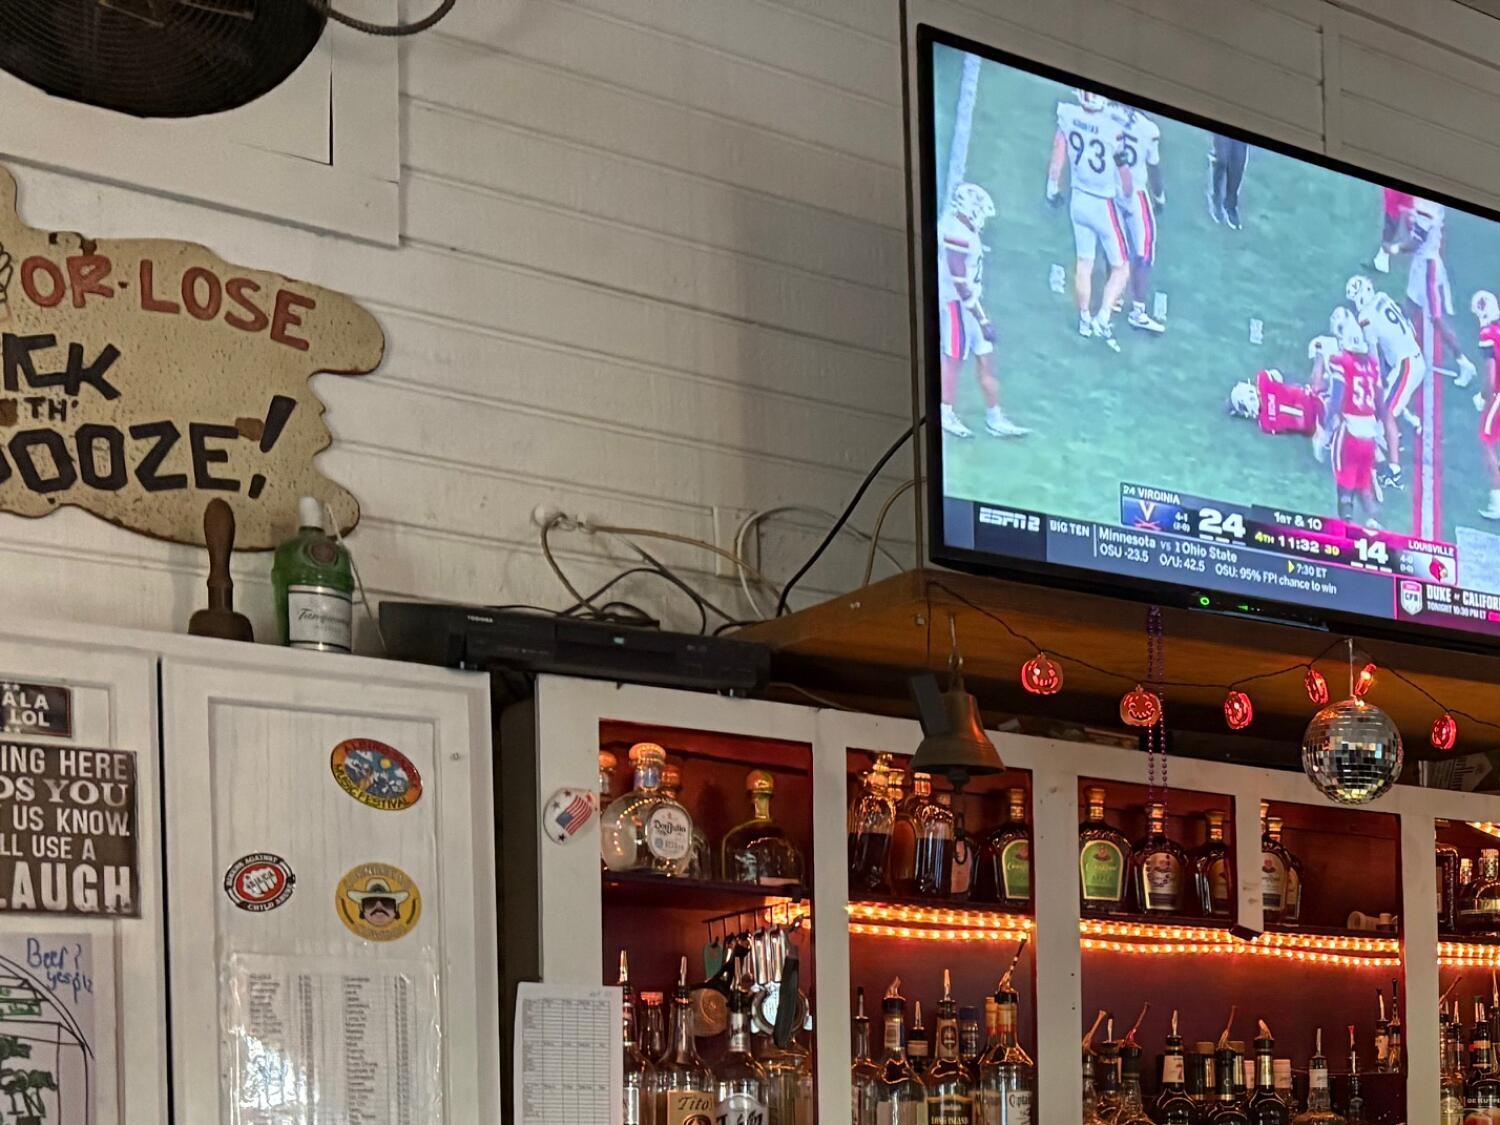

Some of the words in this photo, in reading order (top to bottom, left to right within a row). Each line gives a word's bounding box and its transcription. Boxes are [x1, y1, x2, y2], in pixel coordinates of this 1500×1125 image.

[1069, 131, 1106, 174] 93
[20, 255, 114, 308] OR
[139, 259, 316, 351] LOSE
[0, 395, 297, 498] OOZE!
[1137, 487, 1180, 505] VIRGINIA
[1050, 518, 1068, 534] BIG
[1069, 522, 1090, 538] TEN
[1199, 508, 1246, 539] 24
[1307, 518, 1322, 531] 10
[1099, 528, 1156, 549] Minnesota
[1160, 541, 1172, 552] vs
[1181, 541, 1207, 558] Ohio
[1209, 546, 1238, 563] State
[1278, 536, 1320, 553] 11:32
[1354, 537, 1389, 564] 14
[1408, 540, 1454, 557] LOUISVILLE
[1099, 545, 1122, 559] OSU
[1159, 554, 1182, 569] O/U:
[1183, 558, 1205, 571] 42.5
[1215, 563, 1238, 578] OSU:
[1240, 567, 1261, 583] 95%
[1263, 571, 1278, 585] FPI
[1279, 574, 1310, 591] chance
[1311, 580, 1321, 591] to
[1322, 582, 1337, 595] win
[1316, 566, 1327, 578] ET
[1426, 584, 1452, 603] DUKE
[1, 745, 45, 774] ING
[59, 749, 128, 780] HERE
[43, 779, 128, 807] YOU
[13, 805, 44, 832] US
[56, 808, 131, 837] KNOW.
[32, 834, 72, 859] USE
[82, 838, 96, 861] A
[0, 861, 131, 914] AUGH
